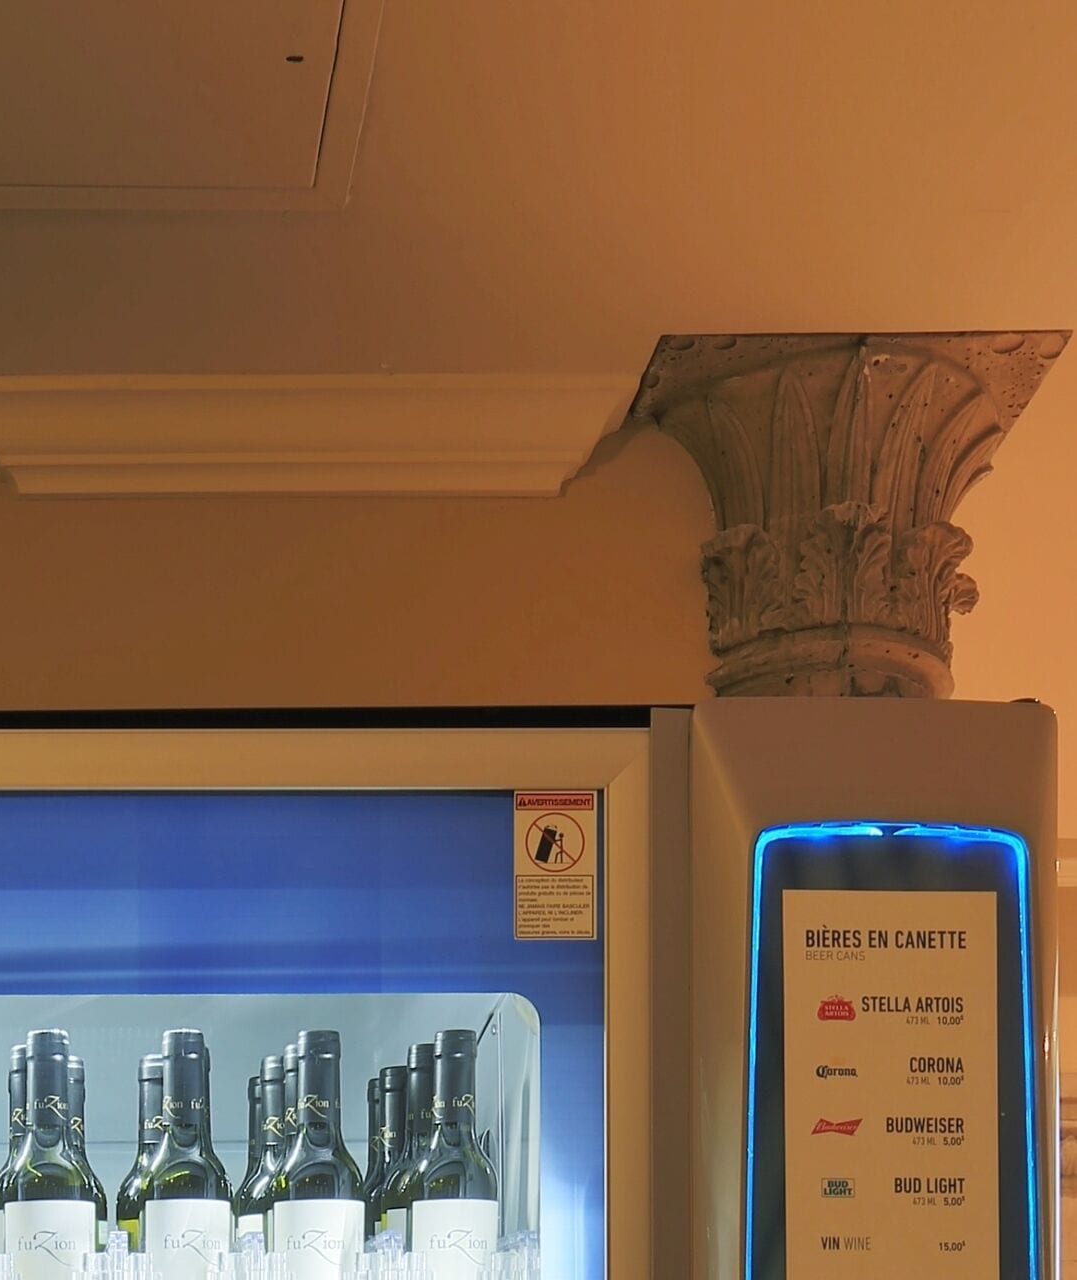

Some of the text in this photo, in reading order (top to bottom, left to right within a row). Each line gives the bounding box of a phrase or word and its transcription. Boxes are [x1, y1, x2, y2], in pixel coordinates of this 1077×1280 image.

[805, 925, 967, 949] BIÈRES EN CANETTE
[805, 951, 866, 961] BEER CANS
[861, 996, 964, 1013] STELLA ARTOIS
[909, 1057, 964, 1073] CORONA
[886, 1117, 964, 1133] BUDWEISER
[823, 1188, 852, 1196] LIGHT
[827, 1180, 849, 1188] BUD
[894, 1178, 965, 1194] BUD LIGHT
[821, 1236, 840, 1250] VIN
[843, 1237, 871, 1250] WINE
